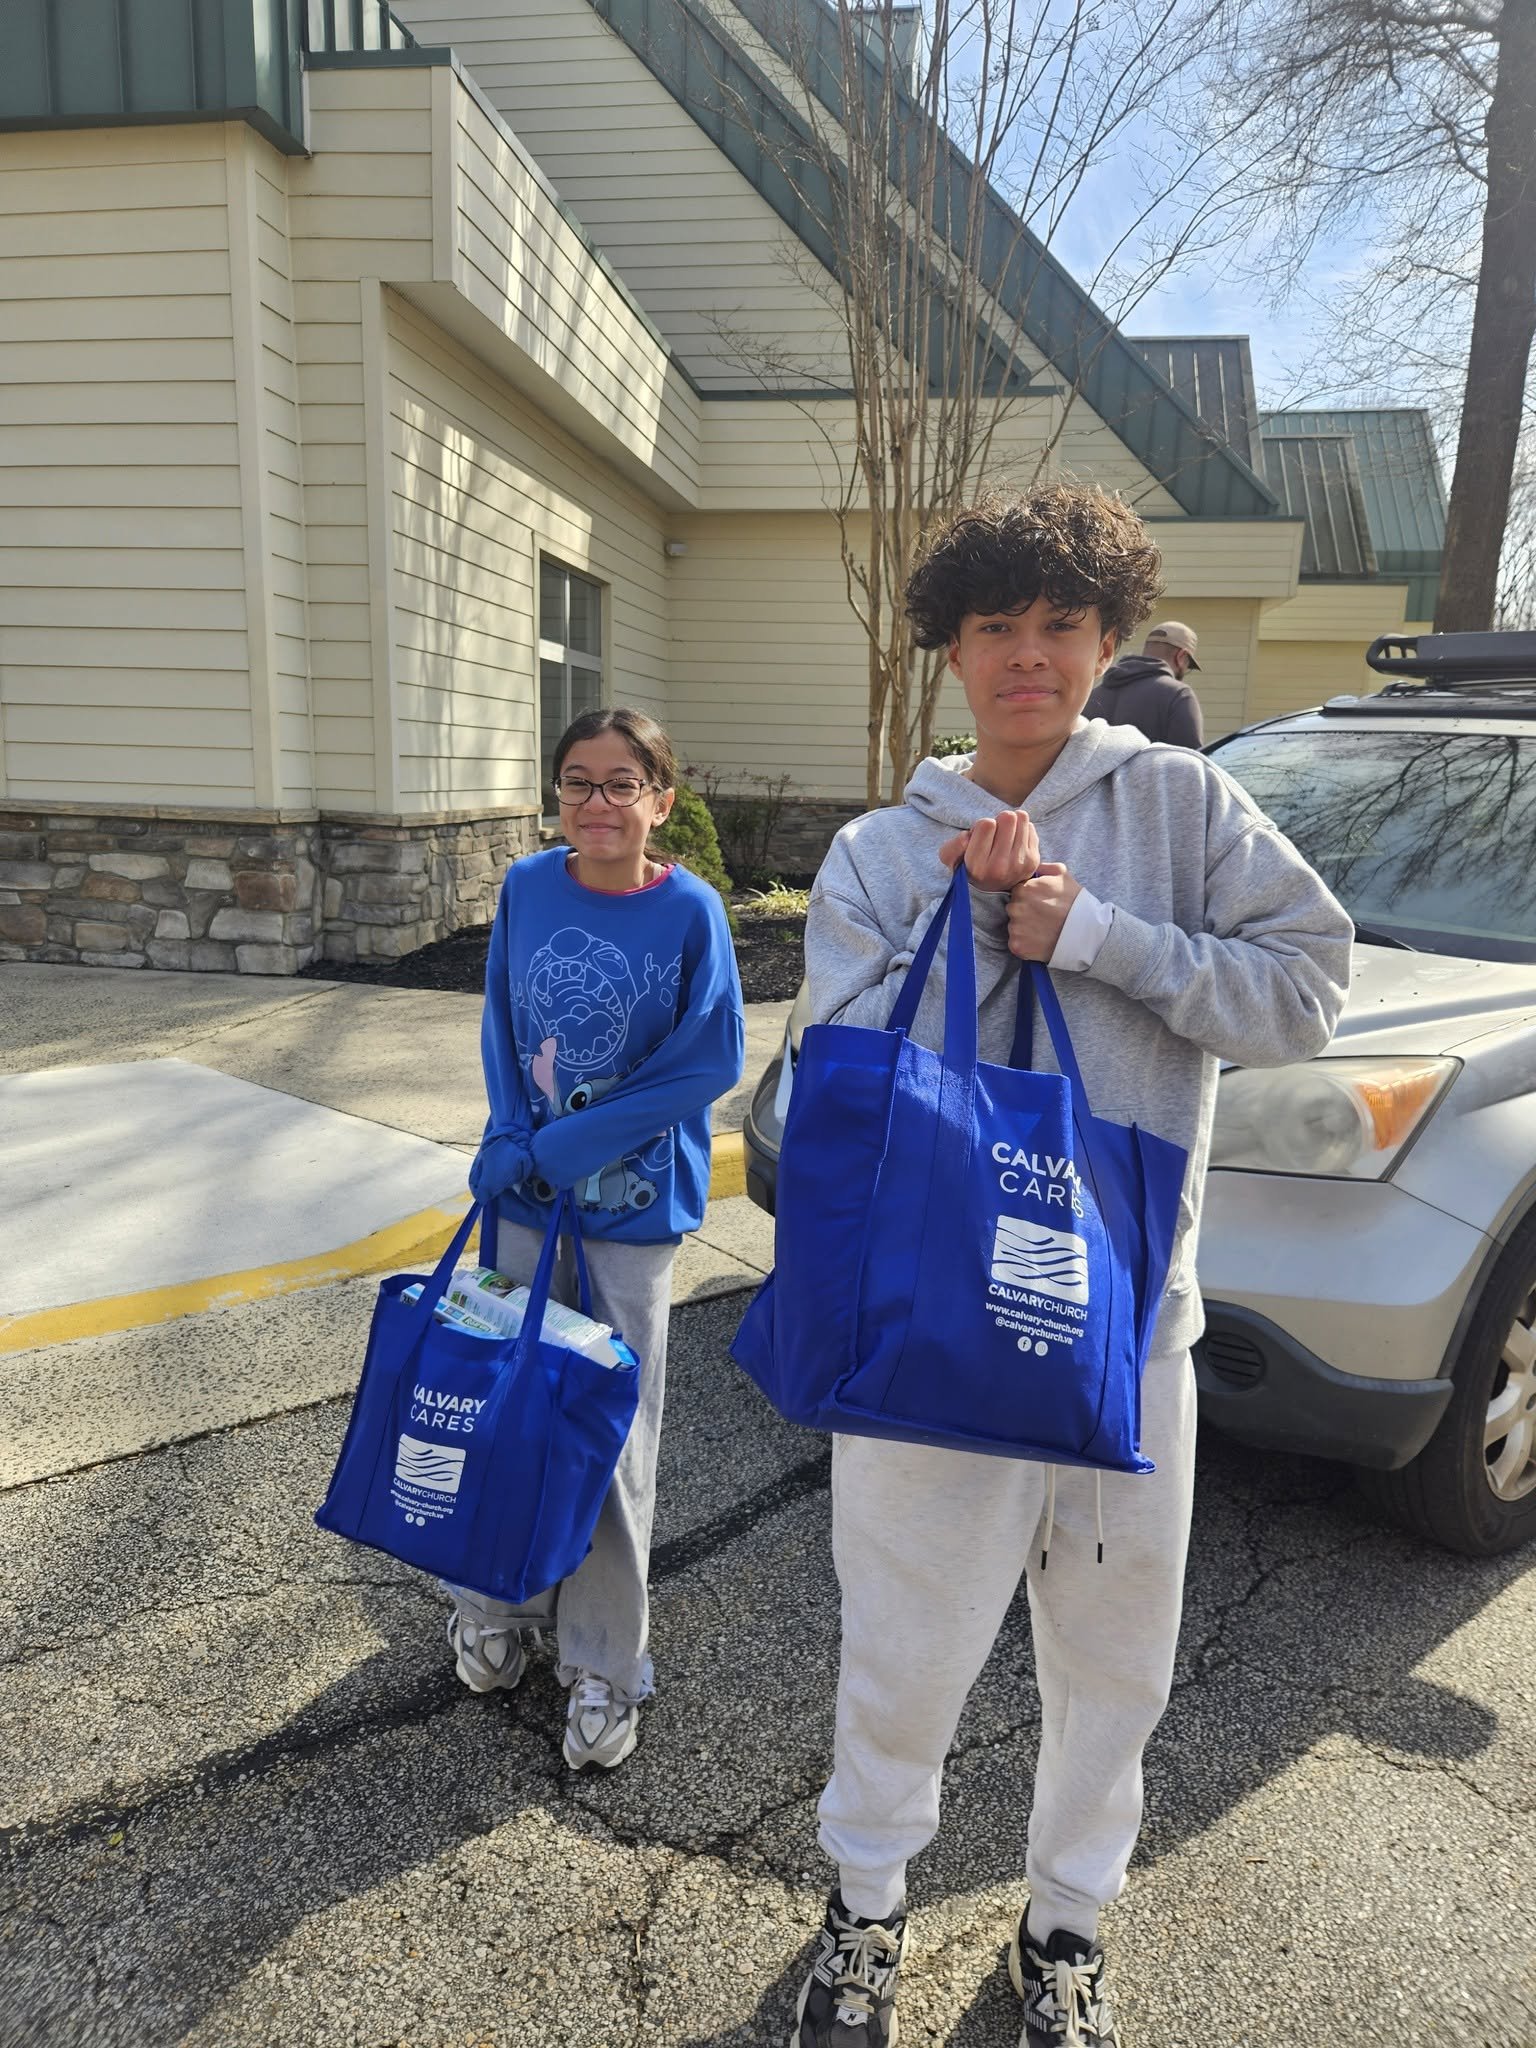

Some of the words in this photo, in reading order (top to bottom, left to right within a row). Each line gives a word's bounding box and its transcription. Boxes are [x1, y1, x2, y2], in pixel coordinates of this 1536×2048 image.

[992, 1142, 1082, 1195] CALVAY
[988, 1283, 1088, 1320] CALVARYCHURCH
[985, 1302, 1085, 1338] www.calvary-church.org
[995, 1316, 1073, 1345] @calvarychurch.va
